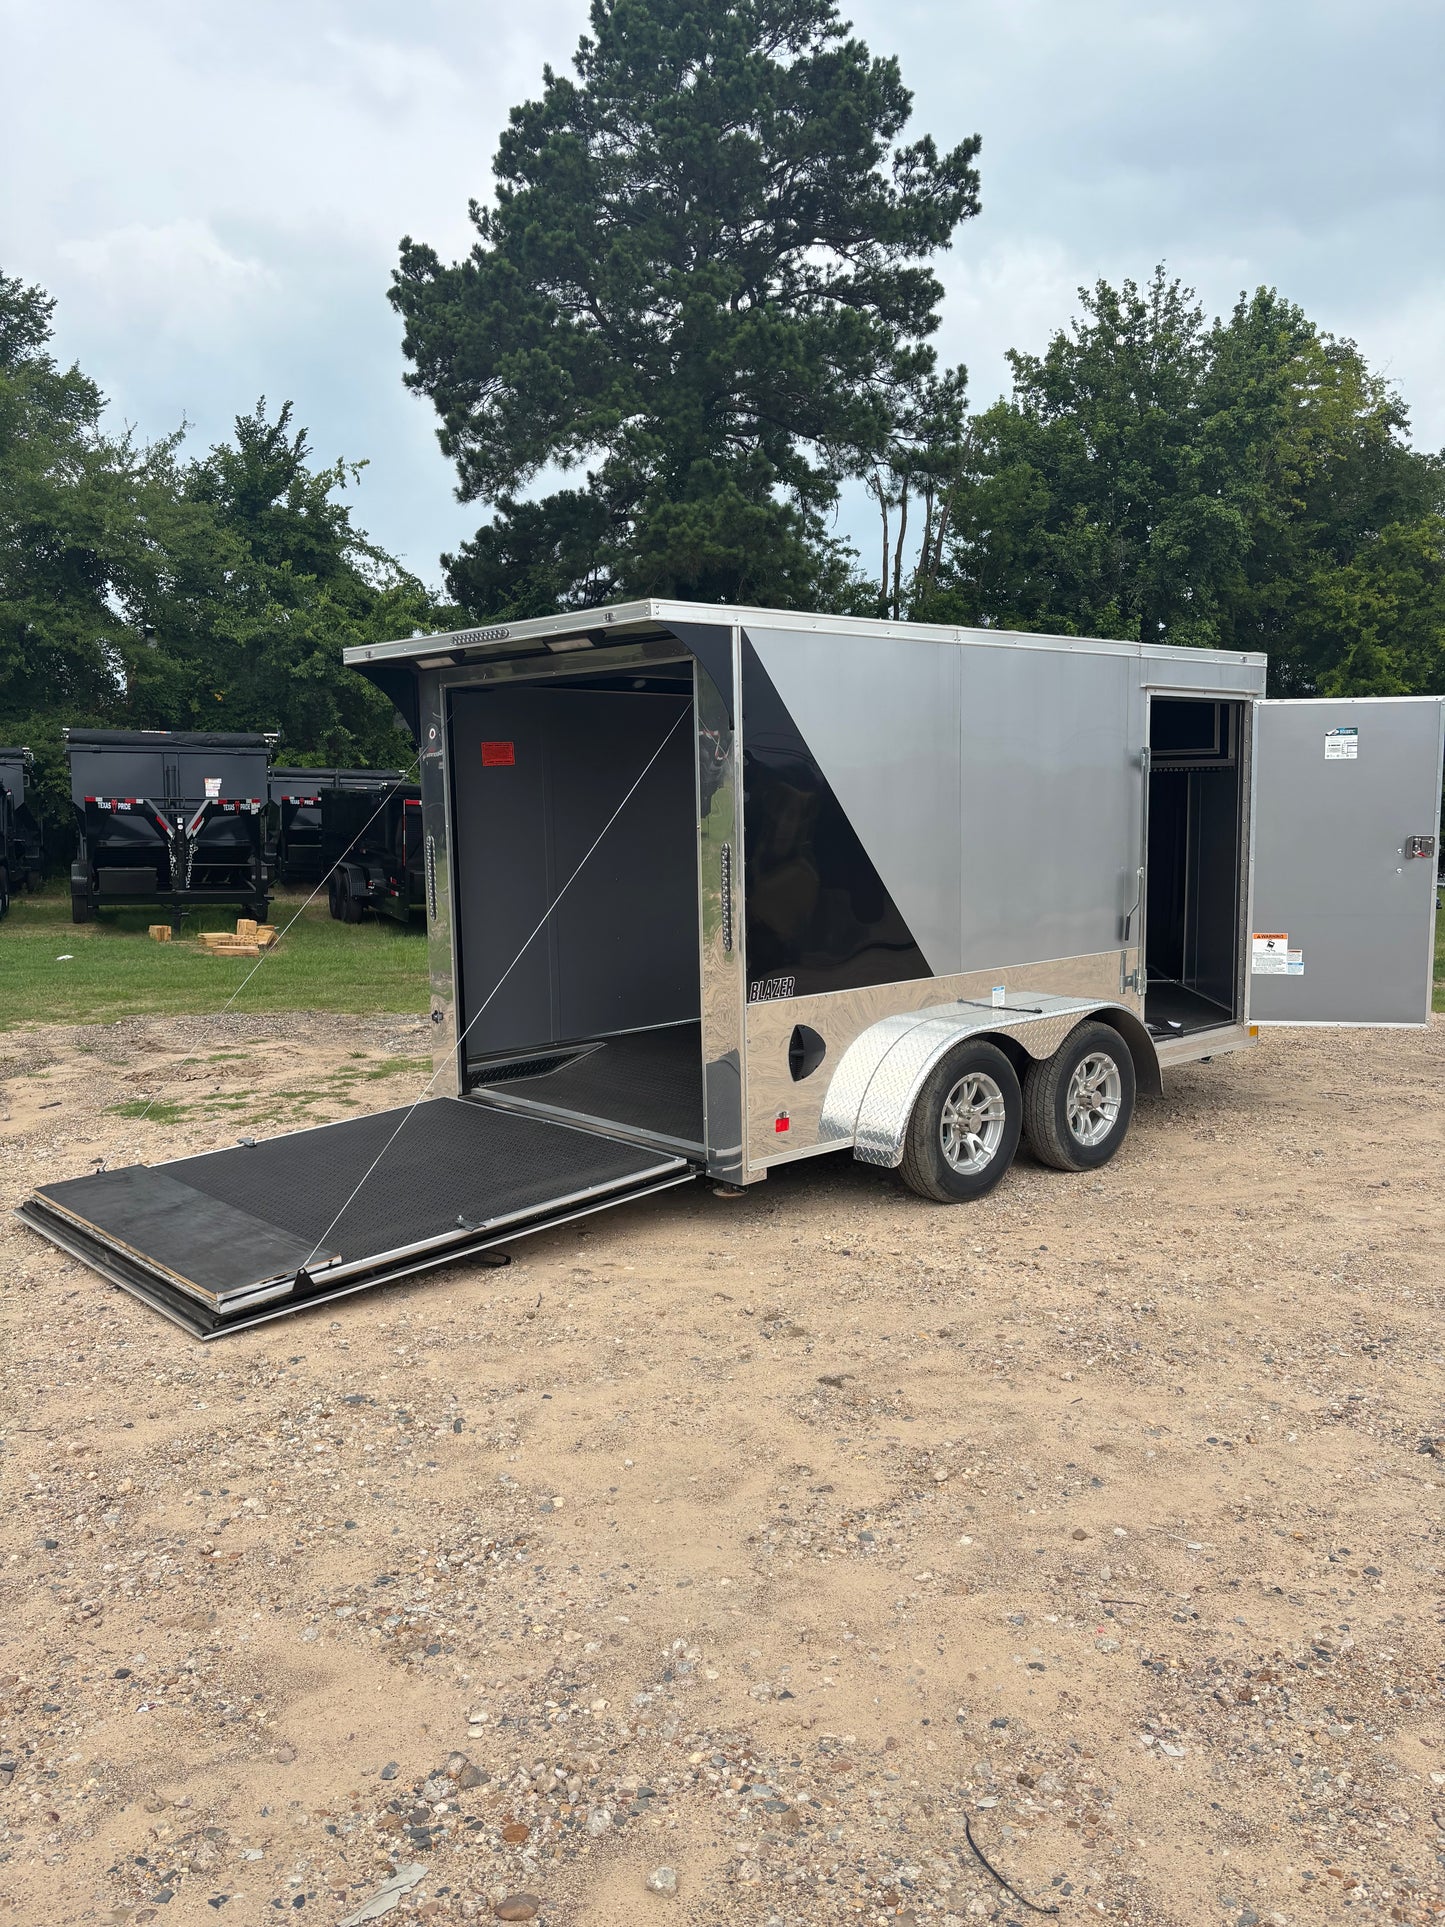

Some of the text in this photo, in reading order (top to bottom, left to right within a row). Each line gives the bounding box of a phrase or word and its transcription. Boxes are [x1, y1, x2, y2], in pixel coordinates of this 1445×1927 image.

[97, 801, 131, 810] TEXAS PRIDE
[749, 976, 795, 1002] BLAZER
